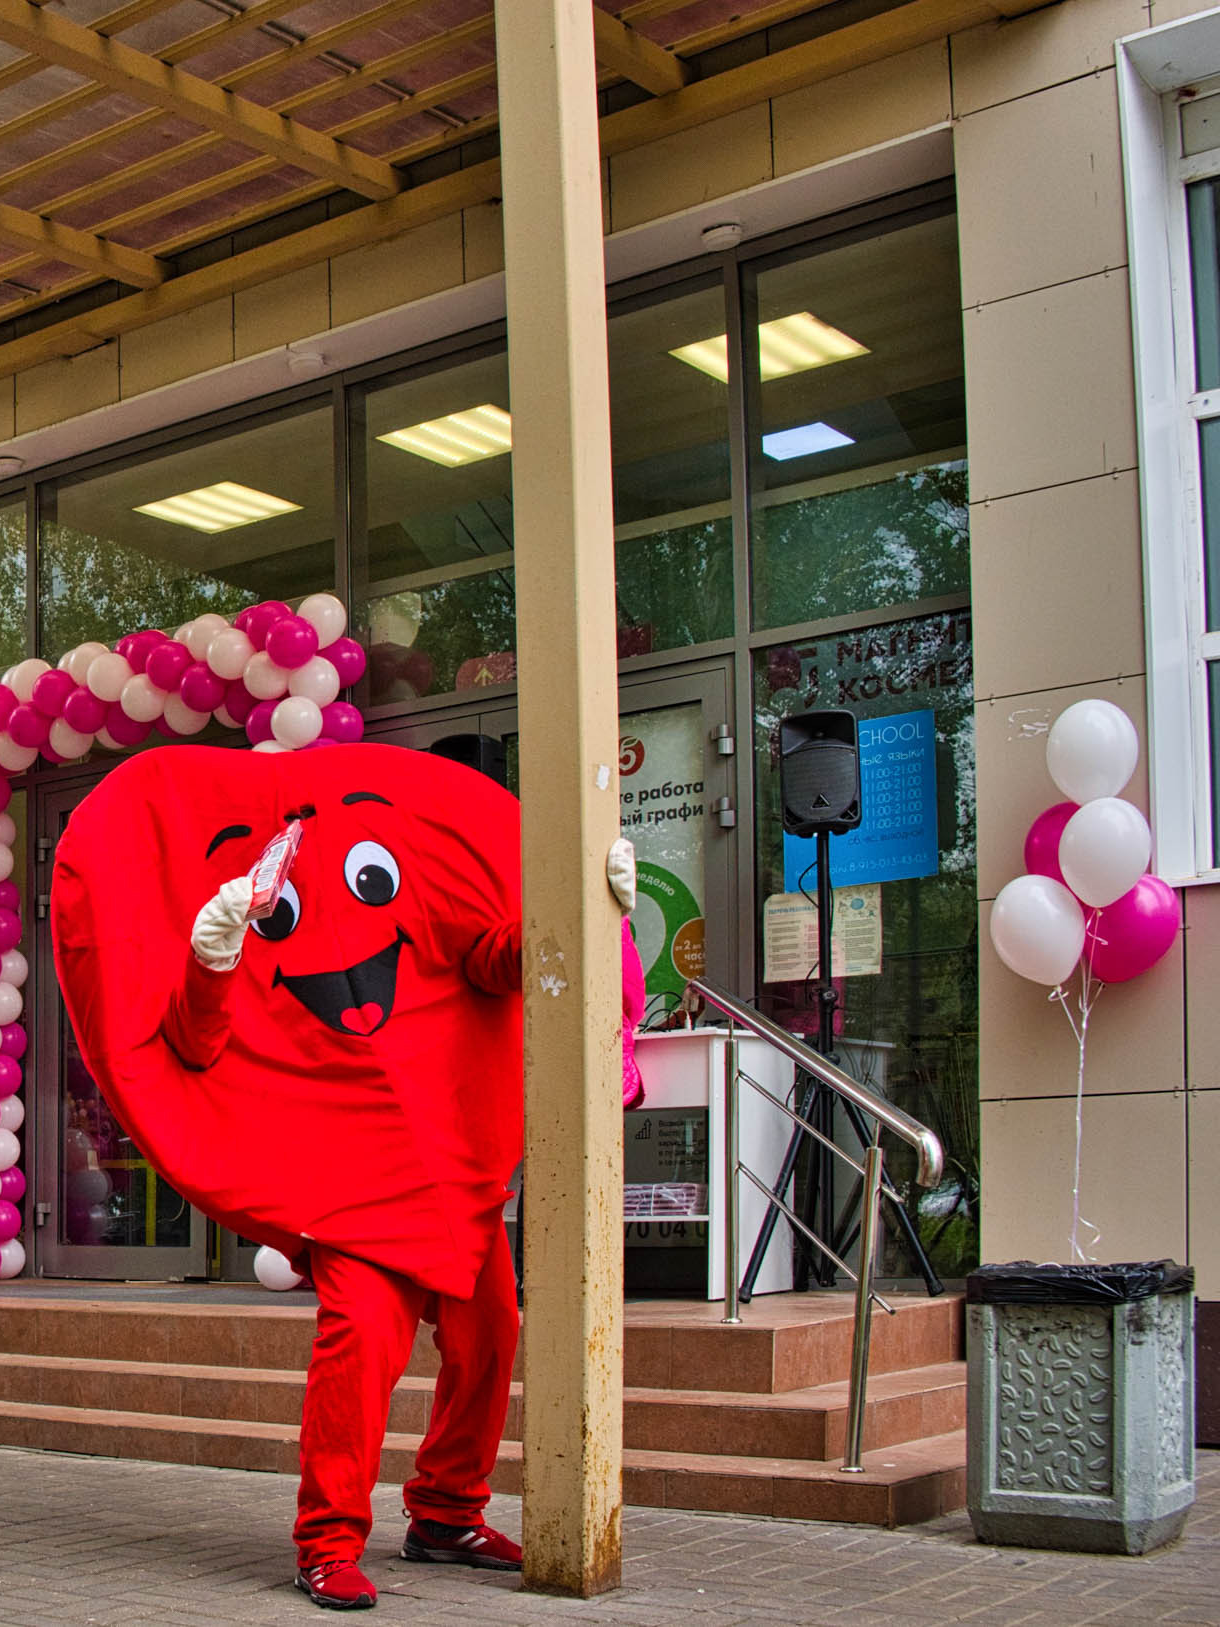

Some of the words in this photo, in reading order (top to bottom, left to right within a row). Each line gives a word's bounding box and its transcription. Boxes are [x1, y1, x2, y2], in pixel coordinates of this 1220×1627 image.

[837, 656, 972, 705] КОСМЕ
[858, 721, 924, 748] CHOOL
[638, 781, 704, 805] работа
[684, 951, 706, 962] час
